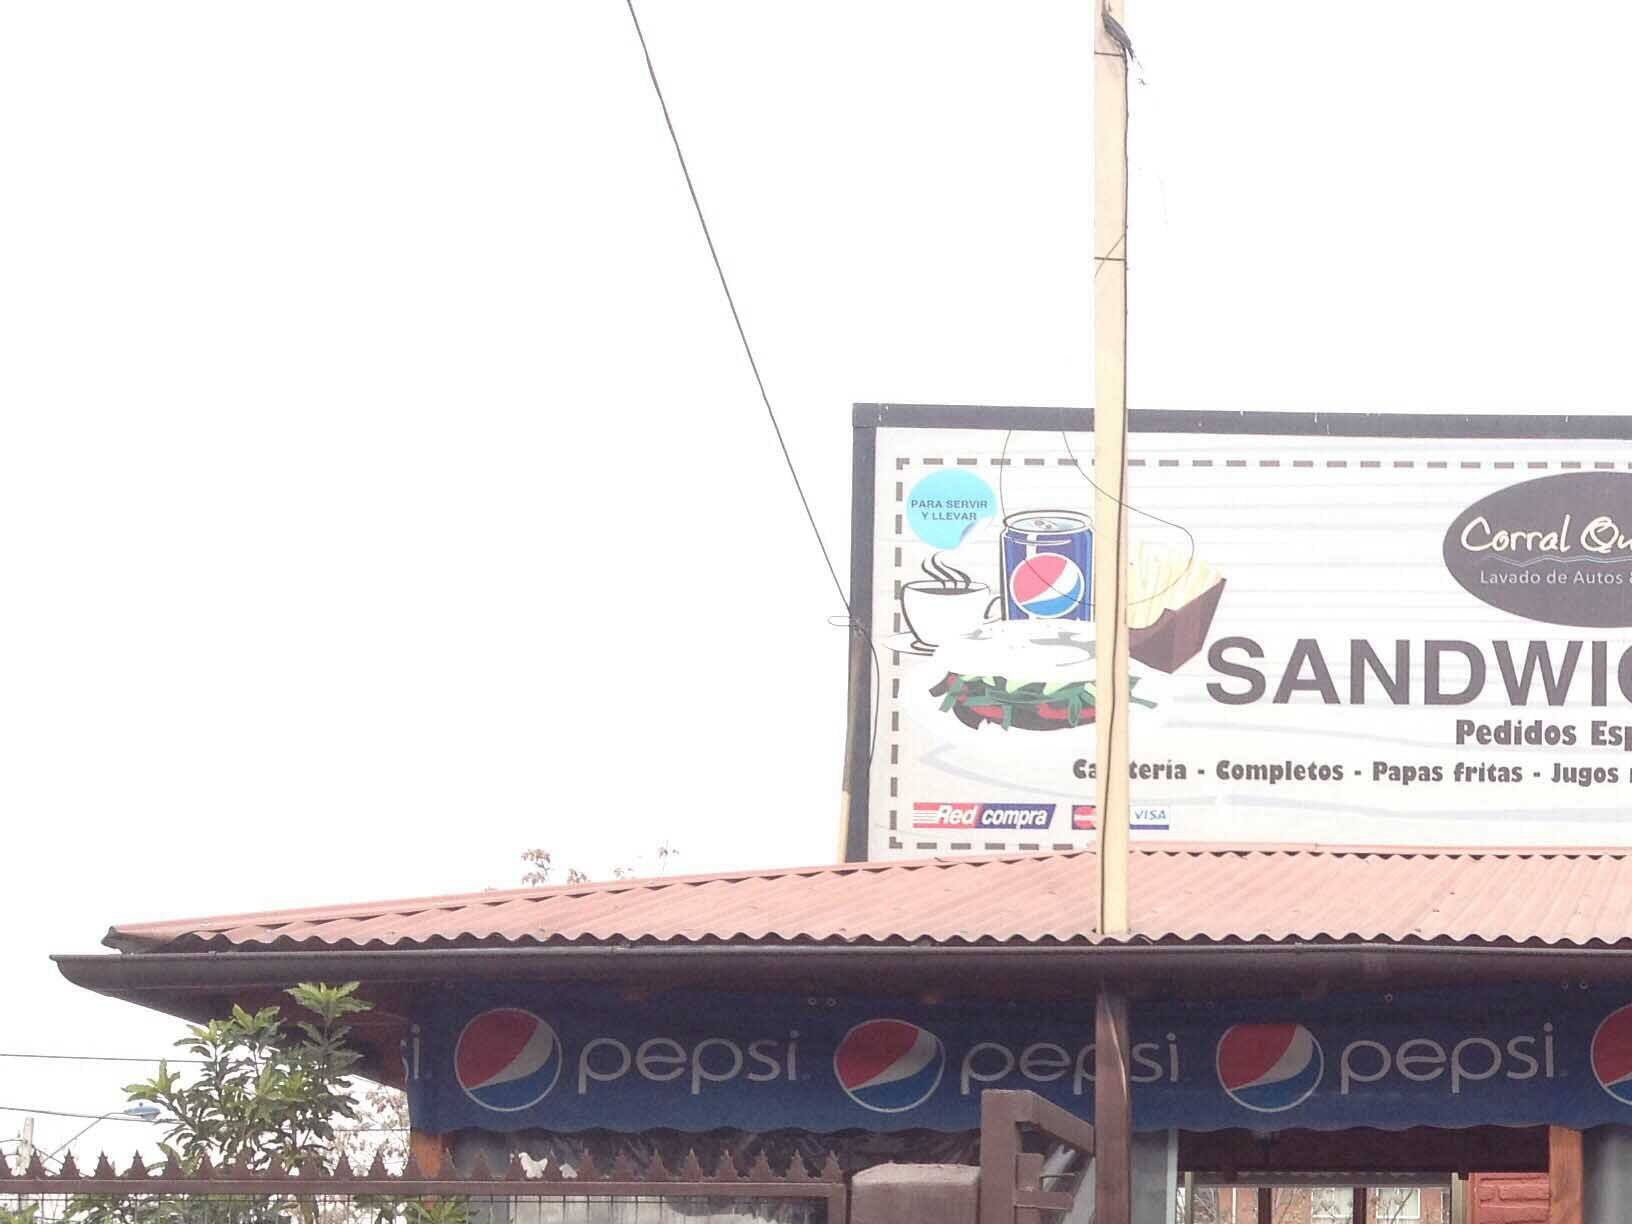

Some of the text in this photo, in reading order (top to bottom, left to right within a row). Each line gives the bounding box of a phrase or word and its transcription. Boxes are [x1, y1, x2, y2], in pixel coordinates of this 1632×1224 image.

[911, 499, 988, 509] PARA SERVIR
[921, 511, 977, 521] Y LLEVAR
[1460, 513, 1571, 553] Corral
[1480, 569, 1541, 585] Lavado
[1546, 569, 1567, 585] de
[1573, 570, 1623, 585] Autos
[1455, 719, 1577, 746] Pedidos
[1072, 759, 1187, 780] Catería
[1215, 759, 1344, 785] Completos
[1372, 761, 1444, 786] Papas
[1453, 762, 1523, 783] fritas
[1551, 762, 1619, 788] Jugos
[936, 805, 1047, 830] Red compra
[1134, 809, 1167, 821] VISA
[577, 1030, 798, 1094] pepsi
[1340, 1022, 1555, 1094] pepsi
